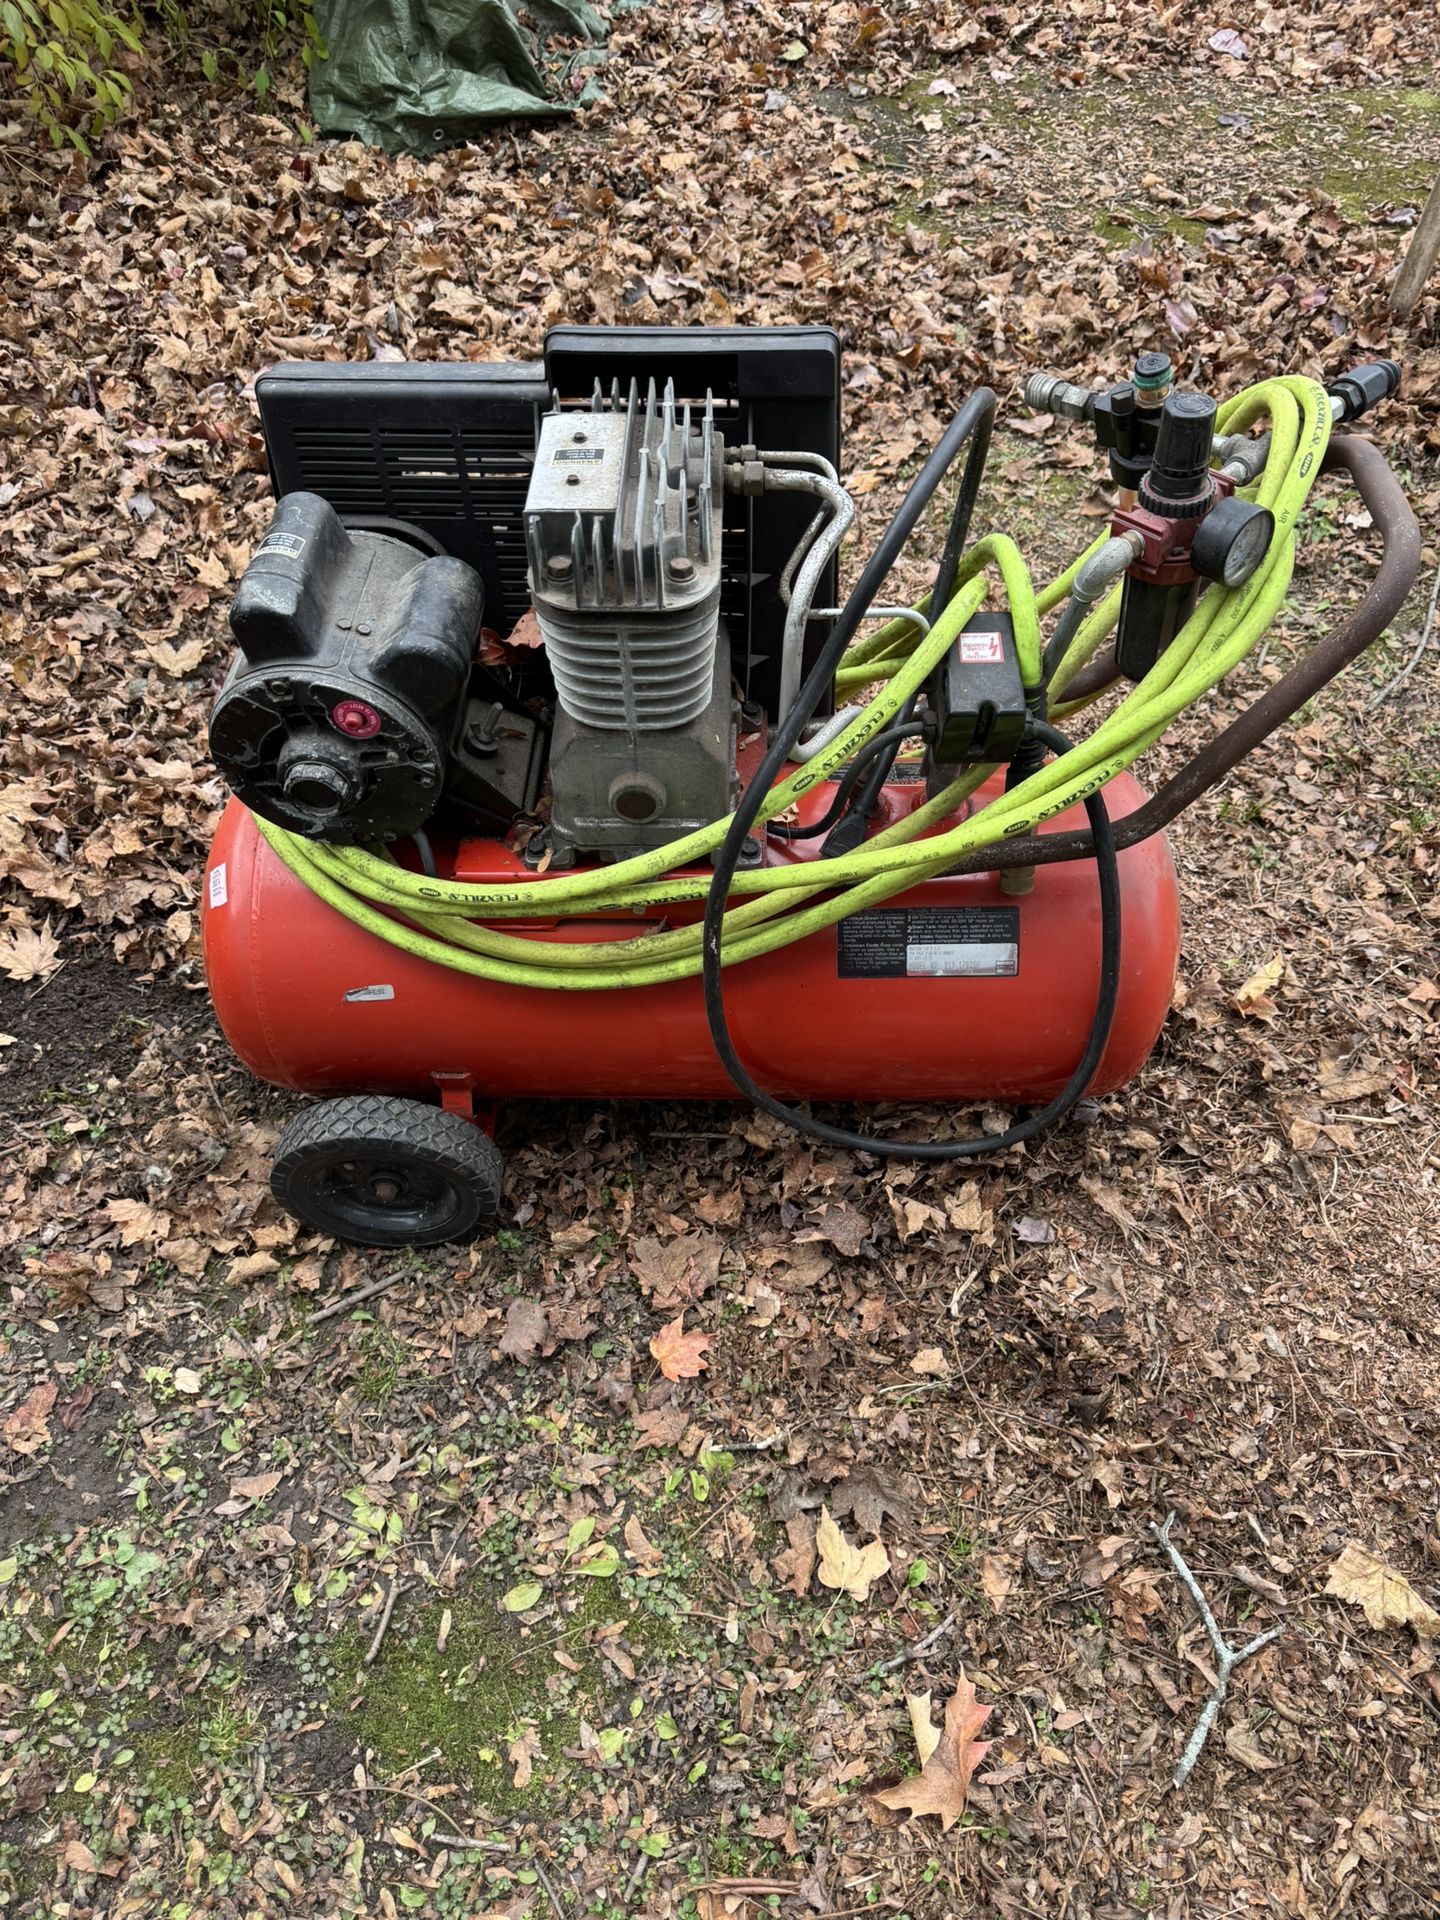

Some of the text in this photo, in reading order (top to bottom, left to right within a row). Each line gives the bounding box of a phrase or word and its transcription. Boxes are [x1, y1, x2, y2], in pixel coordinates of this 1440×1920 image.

[1278, 509, 1290, 524] AIR
[823, 710, 885, 771] FLEXZILLA
[1038, 770, 1110, 820] FLEXZILLA
[962, 840, 975, 850] AIR
[449, 893, 518, 902] FLEXZILLA
[631, 892, 703, 907] FLEXZILLA
[907, 925, 912, 933] 2
[907, 935, 912, 943] 3
